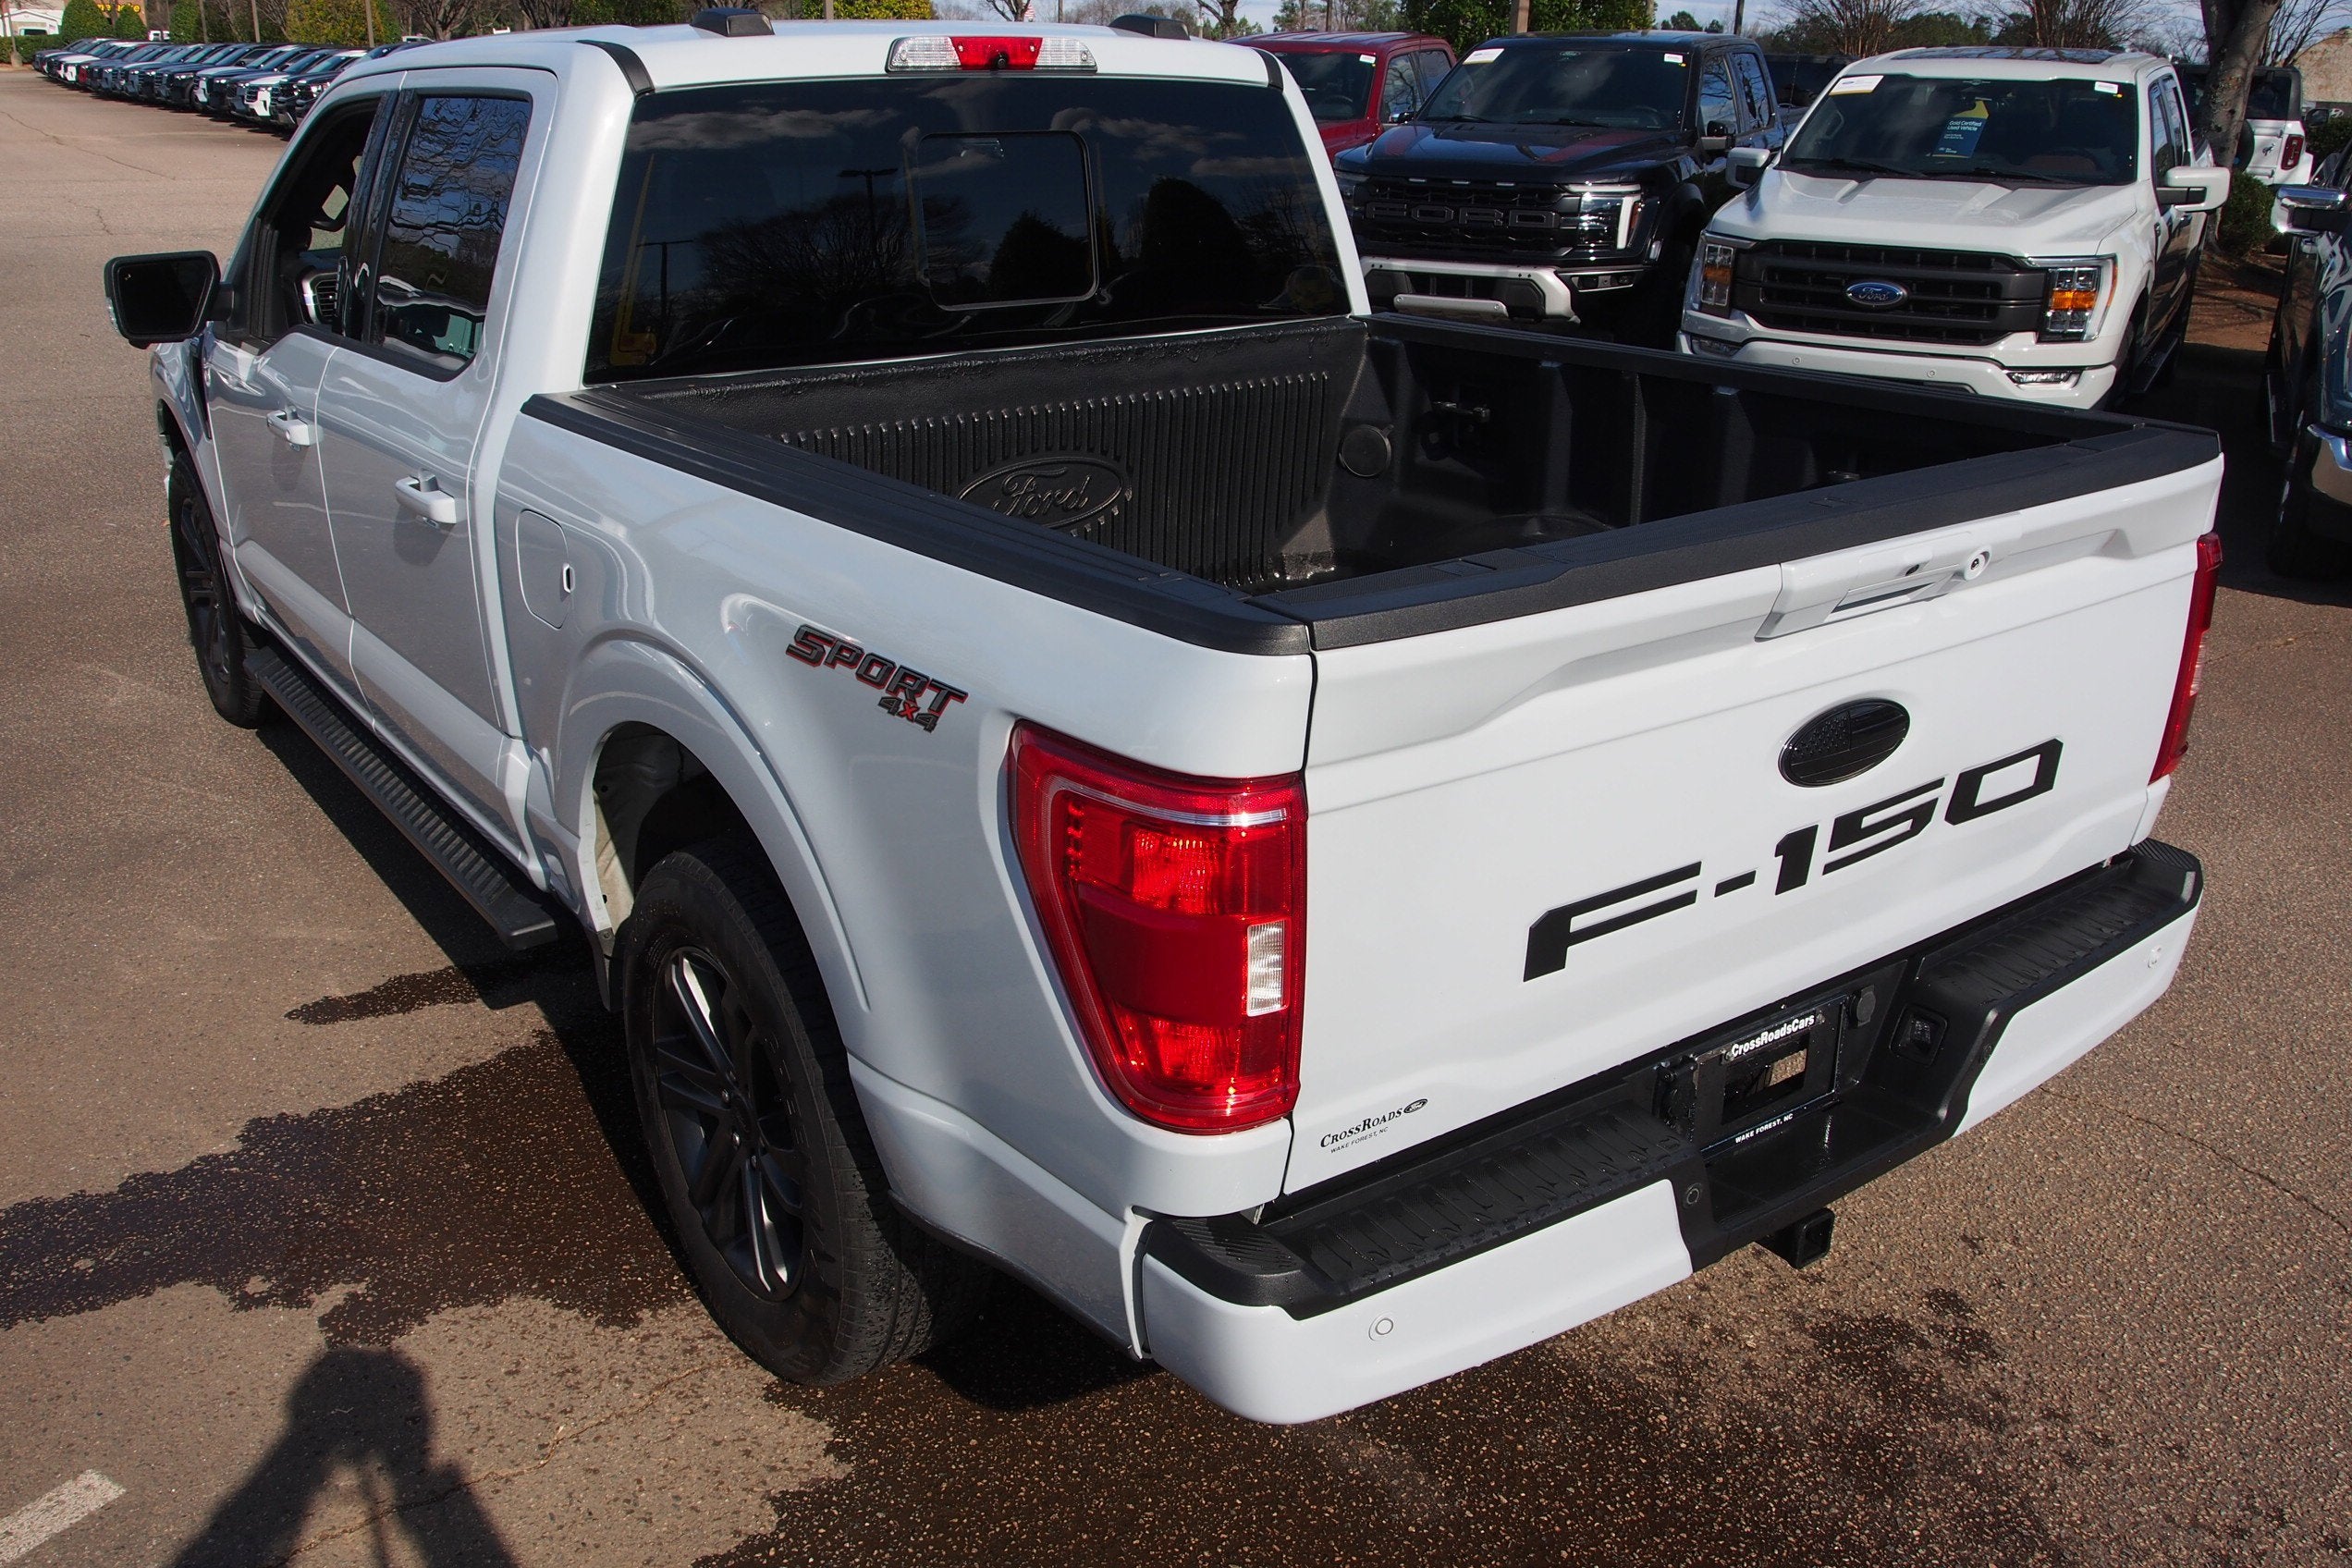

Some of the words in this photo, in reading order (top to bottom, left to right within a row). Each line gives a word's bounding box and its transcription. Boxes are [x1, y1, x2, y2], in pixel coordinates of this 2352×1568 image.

[1366, 202, 1561, 228] FORD
[992, 467, 1091, 518] Ford
[786, 623, 969, 717] SPORT
[1524, 737, 2064, 982] F-150
[1731, 1014, 1815, 1058] CrossRoadsCars
[1330, 1142, 1350, 1154] WAKE
[1378, 1126, 1389, 1134] NC
[1734, 1130, 1755, 1144] WAKE
[1756, 1119, 1782, 1134] FOREST,
[1783, 1113, 1794, 1122] NC
